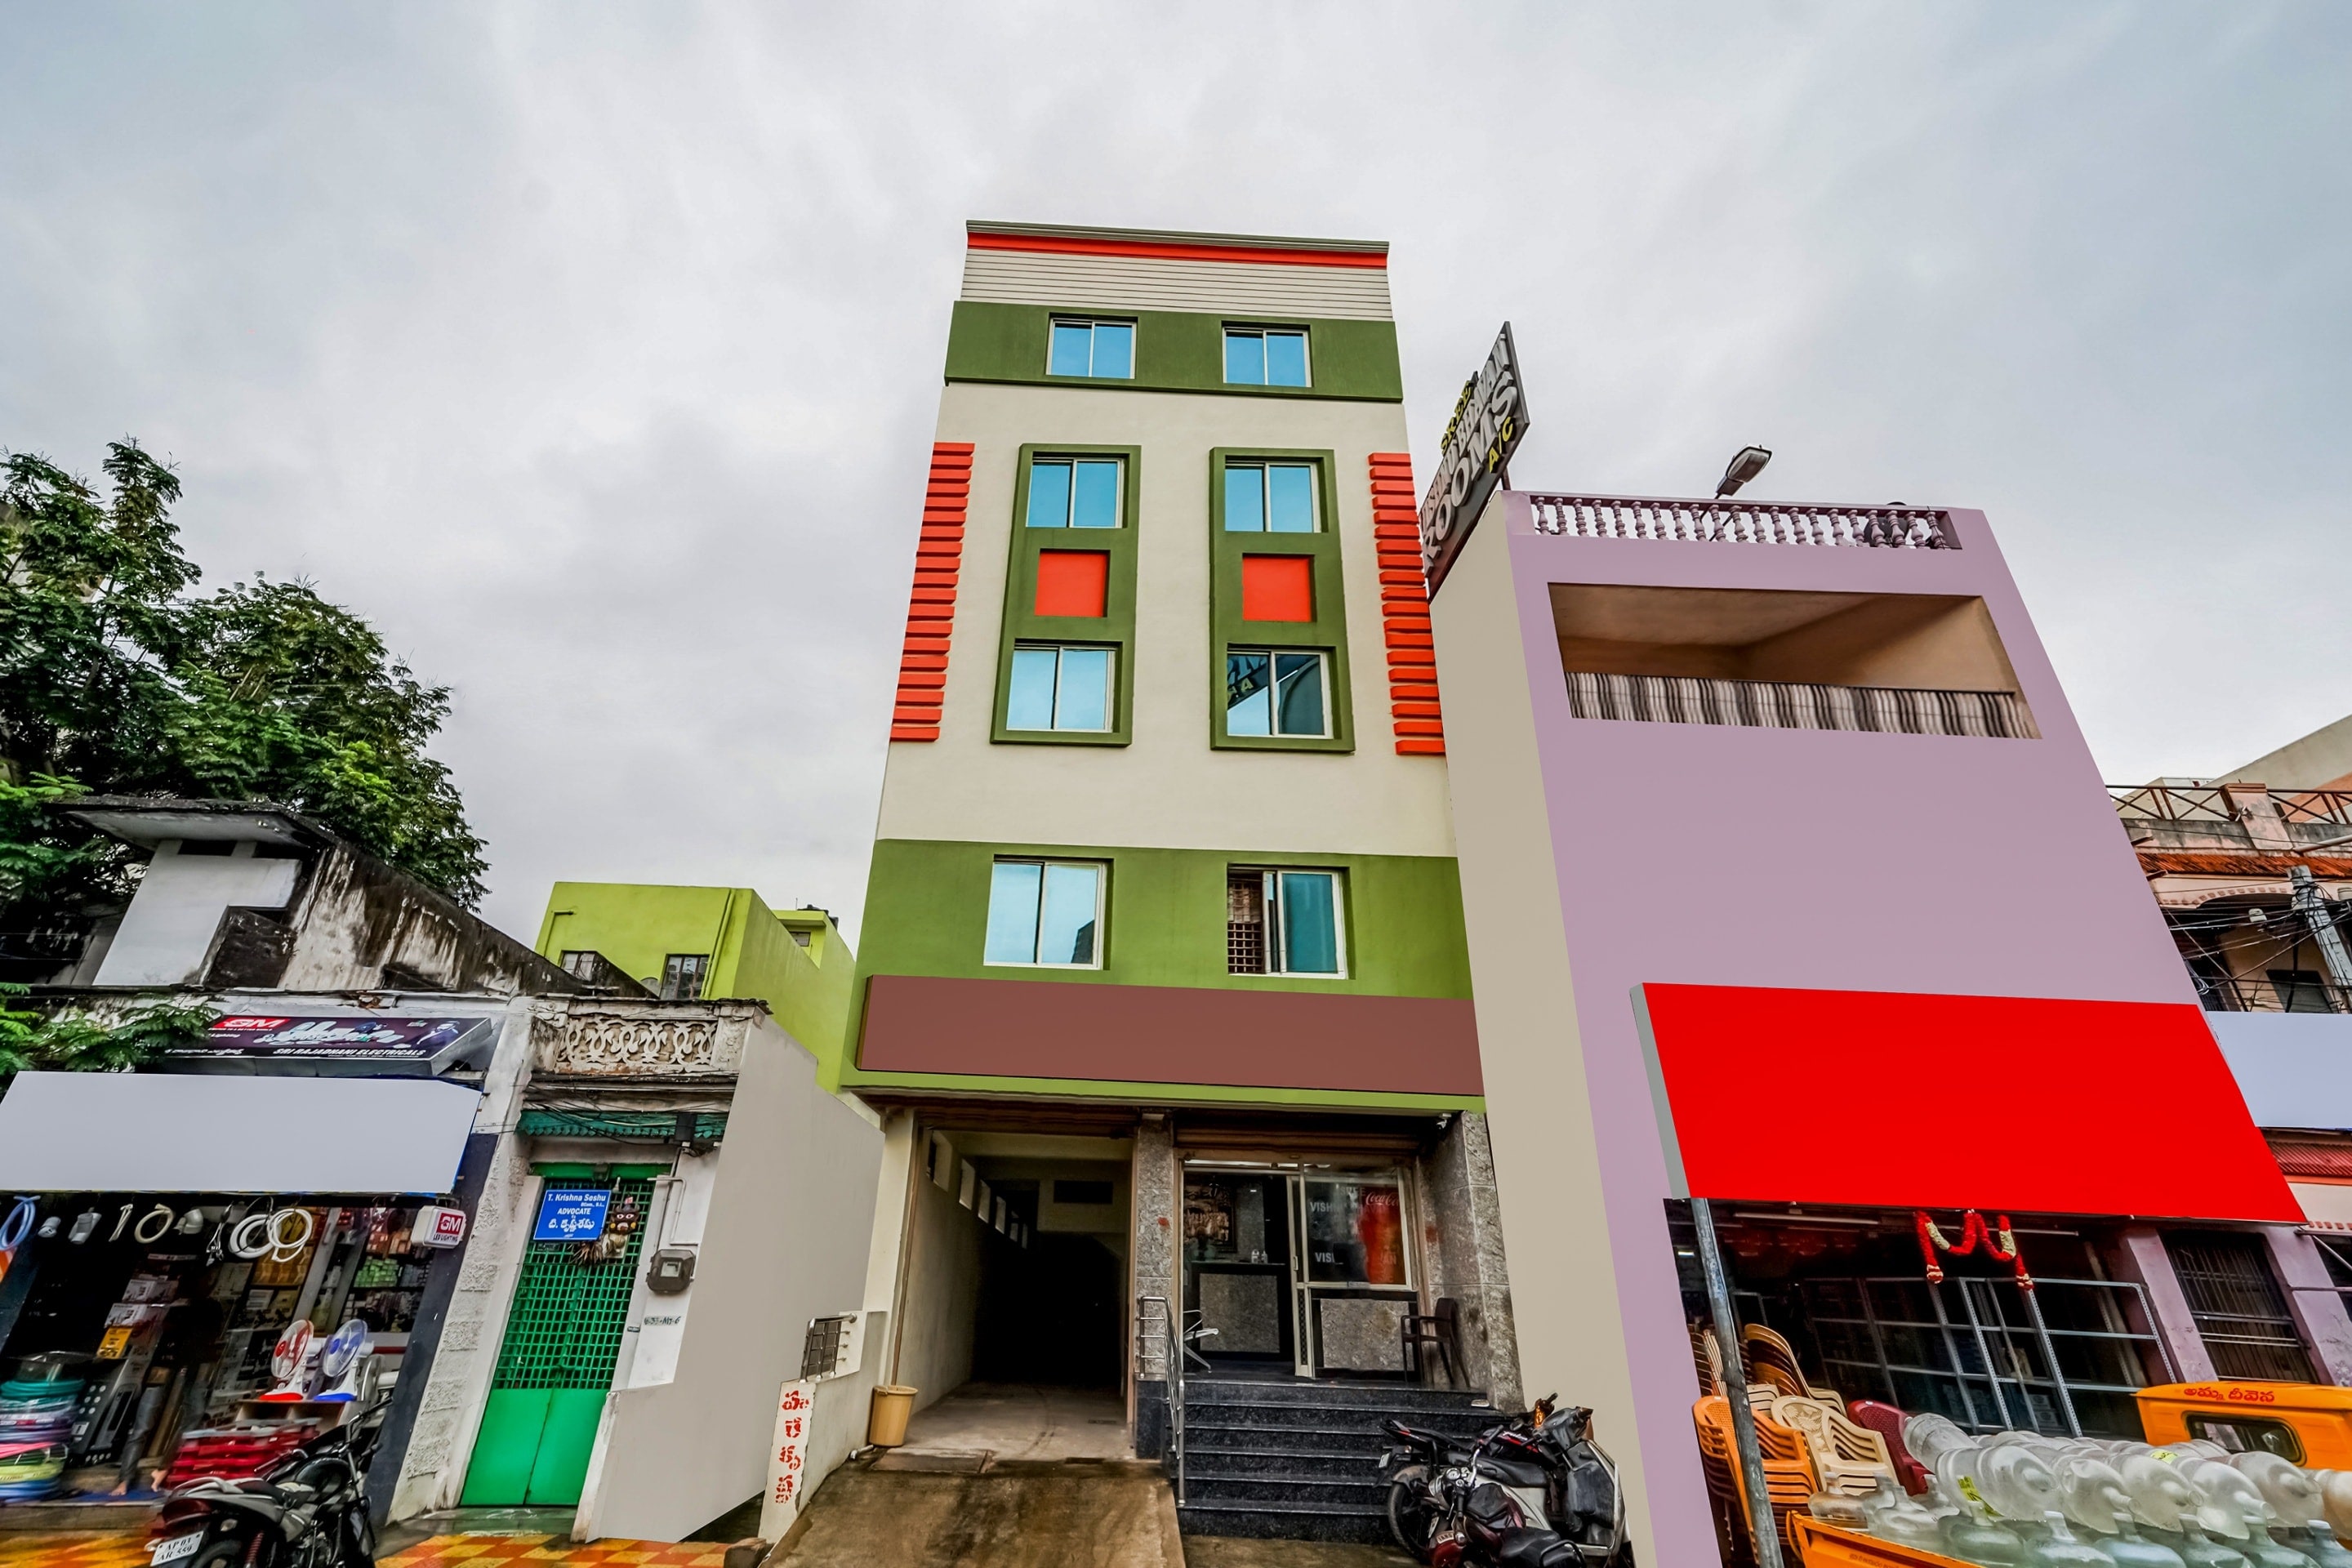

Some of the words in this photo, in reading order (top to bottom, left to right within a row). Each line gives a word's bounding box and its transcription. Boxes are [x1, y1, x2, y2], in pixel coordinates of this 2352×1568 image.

[1441, 380, 1472, 457] SREE
[1456, 333, 1510, 458] BHAVAN
[1423, 371, 1517, 577] ROOMS
[1489, 416, 1513, 473] A/C
[224, 1018, 284, 1028] GM
[441, 1216, 462, 1232] GM
